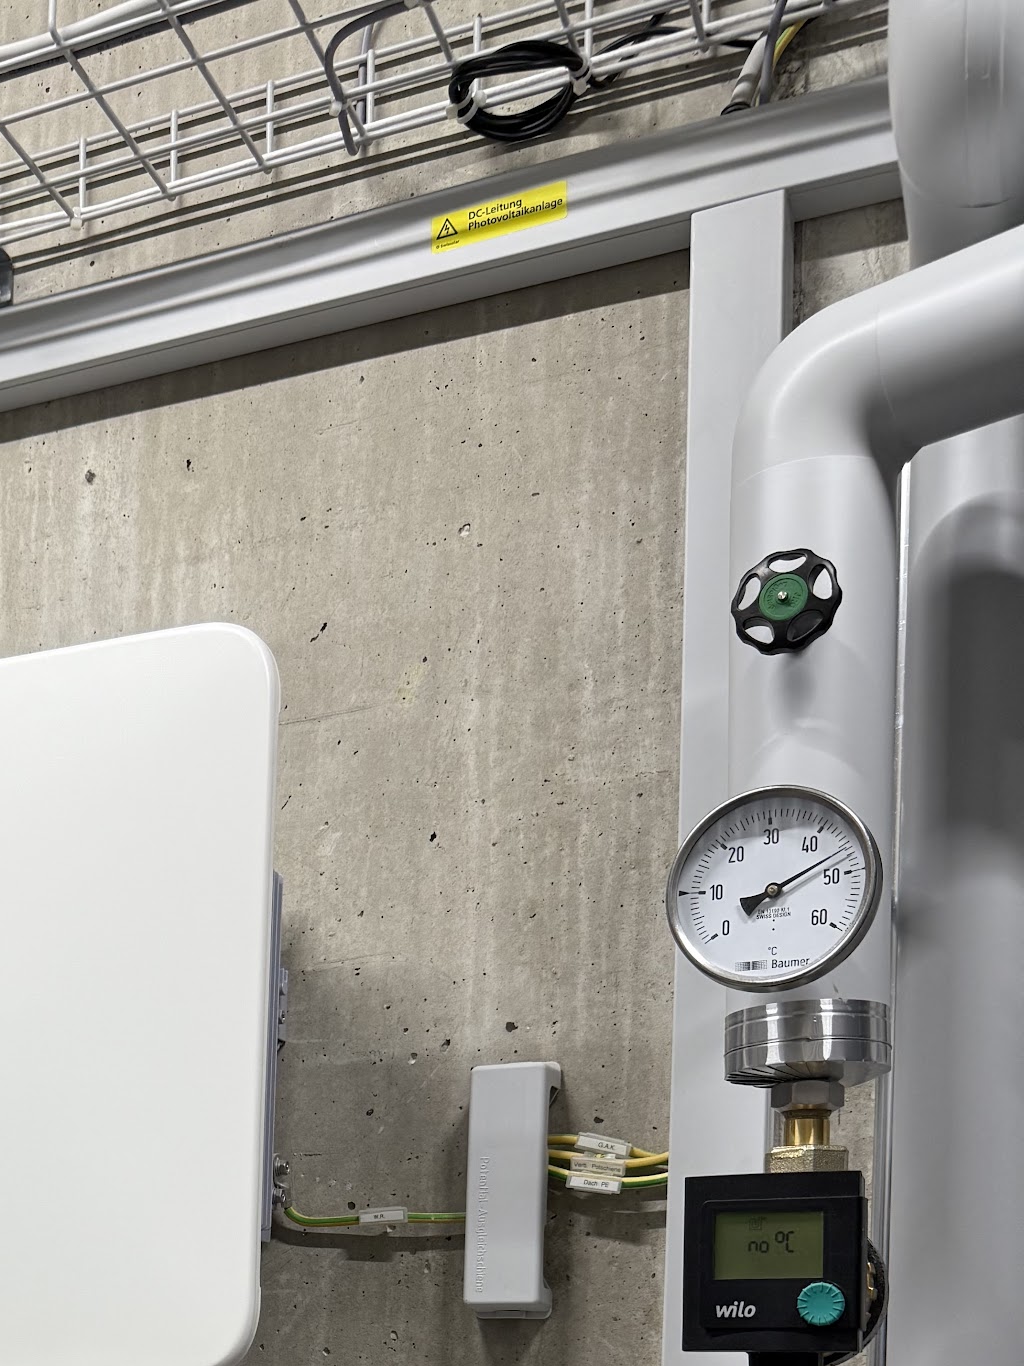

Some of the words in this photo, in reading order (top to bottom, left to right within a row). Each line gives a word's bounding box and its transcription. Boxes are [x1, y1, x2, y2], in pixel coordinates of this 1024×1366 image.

[468, 199, 522, 220] DC-Leitung
[468, 198, 563, 231] Photovoltaikanlage
[763, 828, 780, 845] 30
[801, 835, 818, 853] 40
[728, 846, 744, 864] 20
[823, 867, 840, 885] 50
[709, 884, 723, 901] 10
[811, 908, 828, 926] 60
[722, 920, 730, 936] 0
[768, 946, 778, 956] °C
[771, 958, 810, 969] Baumer
[583, 1179, 598, 1187] Dach
[716, 1301, 756, 1318] wilo
